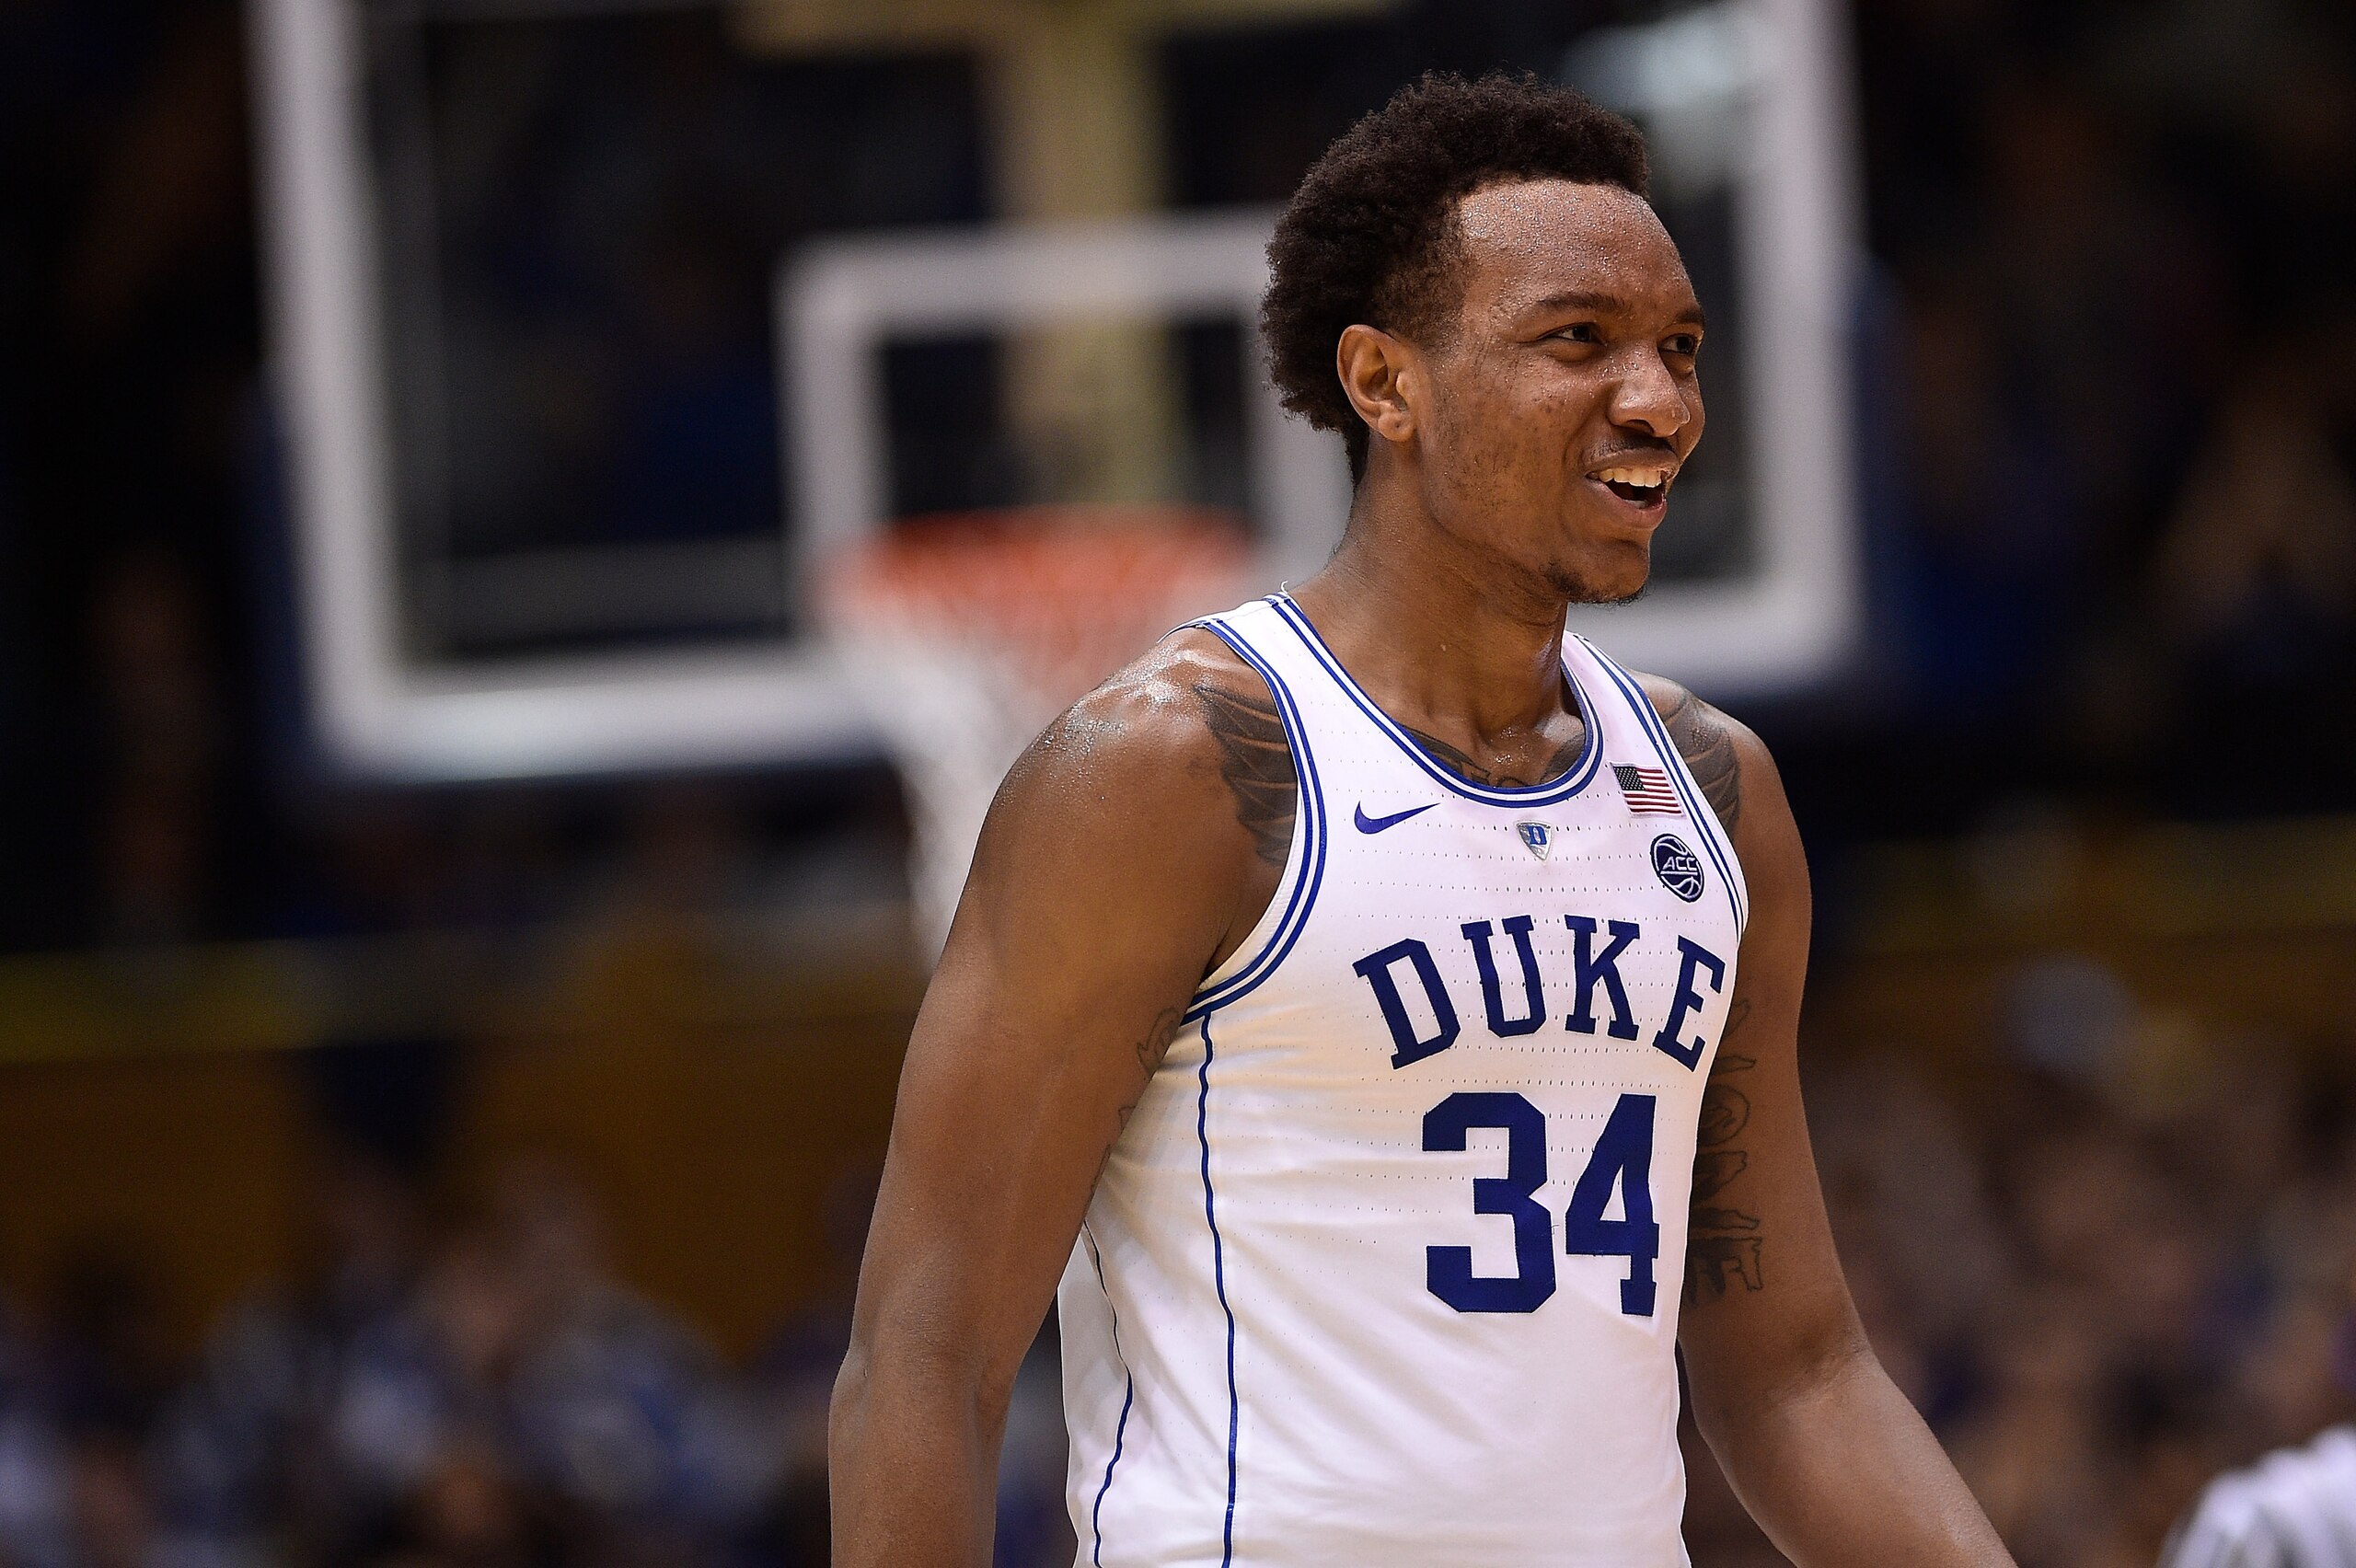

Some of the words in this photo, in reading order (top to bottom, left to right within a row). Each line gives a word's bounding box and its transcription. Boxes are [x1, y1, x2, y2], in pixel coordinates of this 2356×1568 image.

[1663, 857, 1697, 871] ACC
[1352, 915, 1726, 1072] DUKE
[1423, 1092, 1660, 1317] 34
